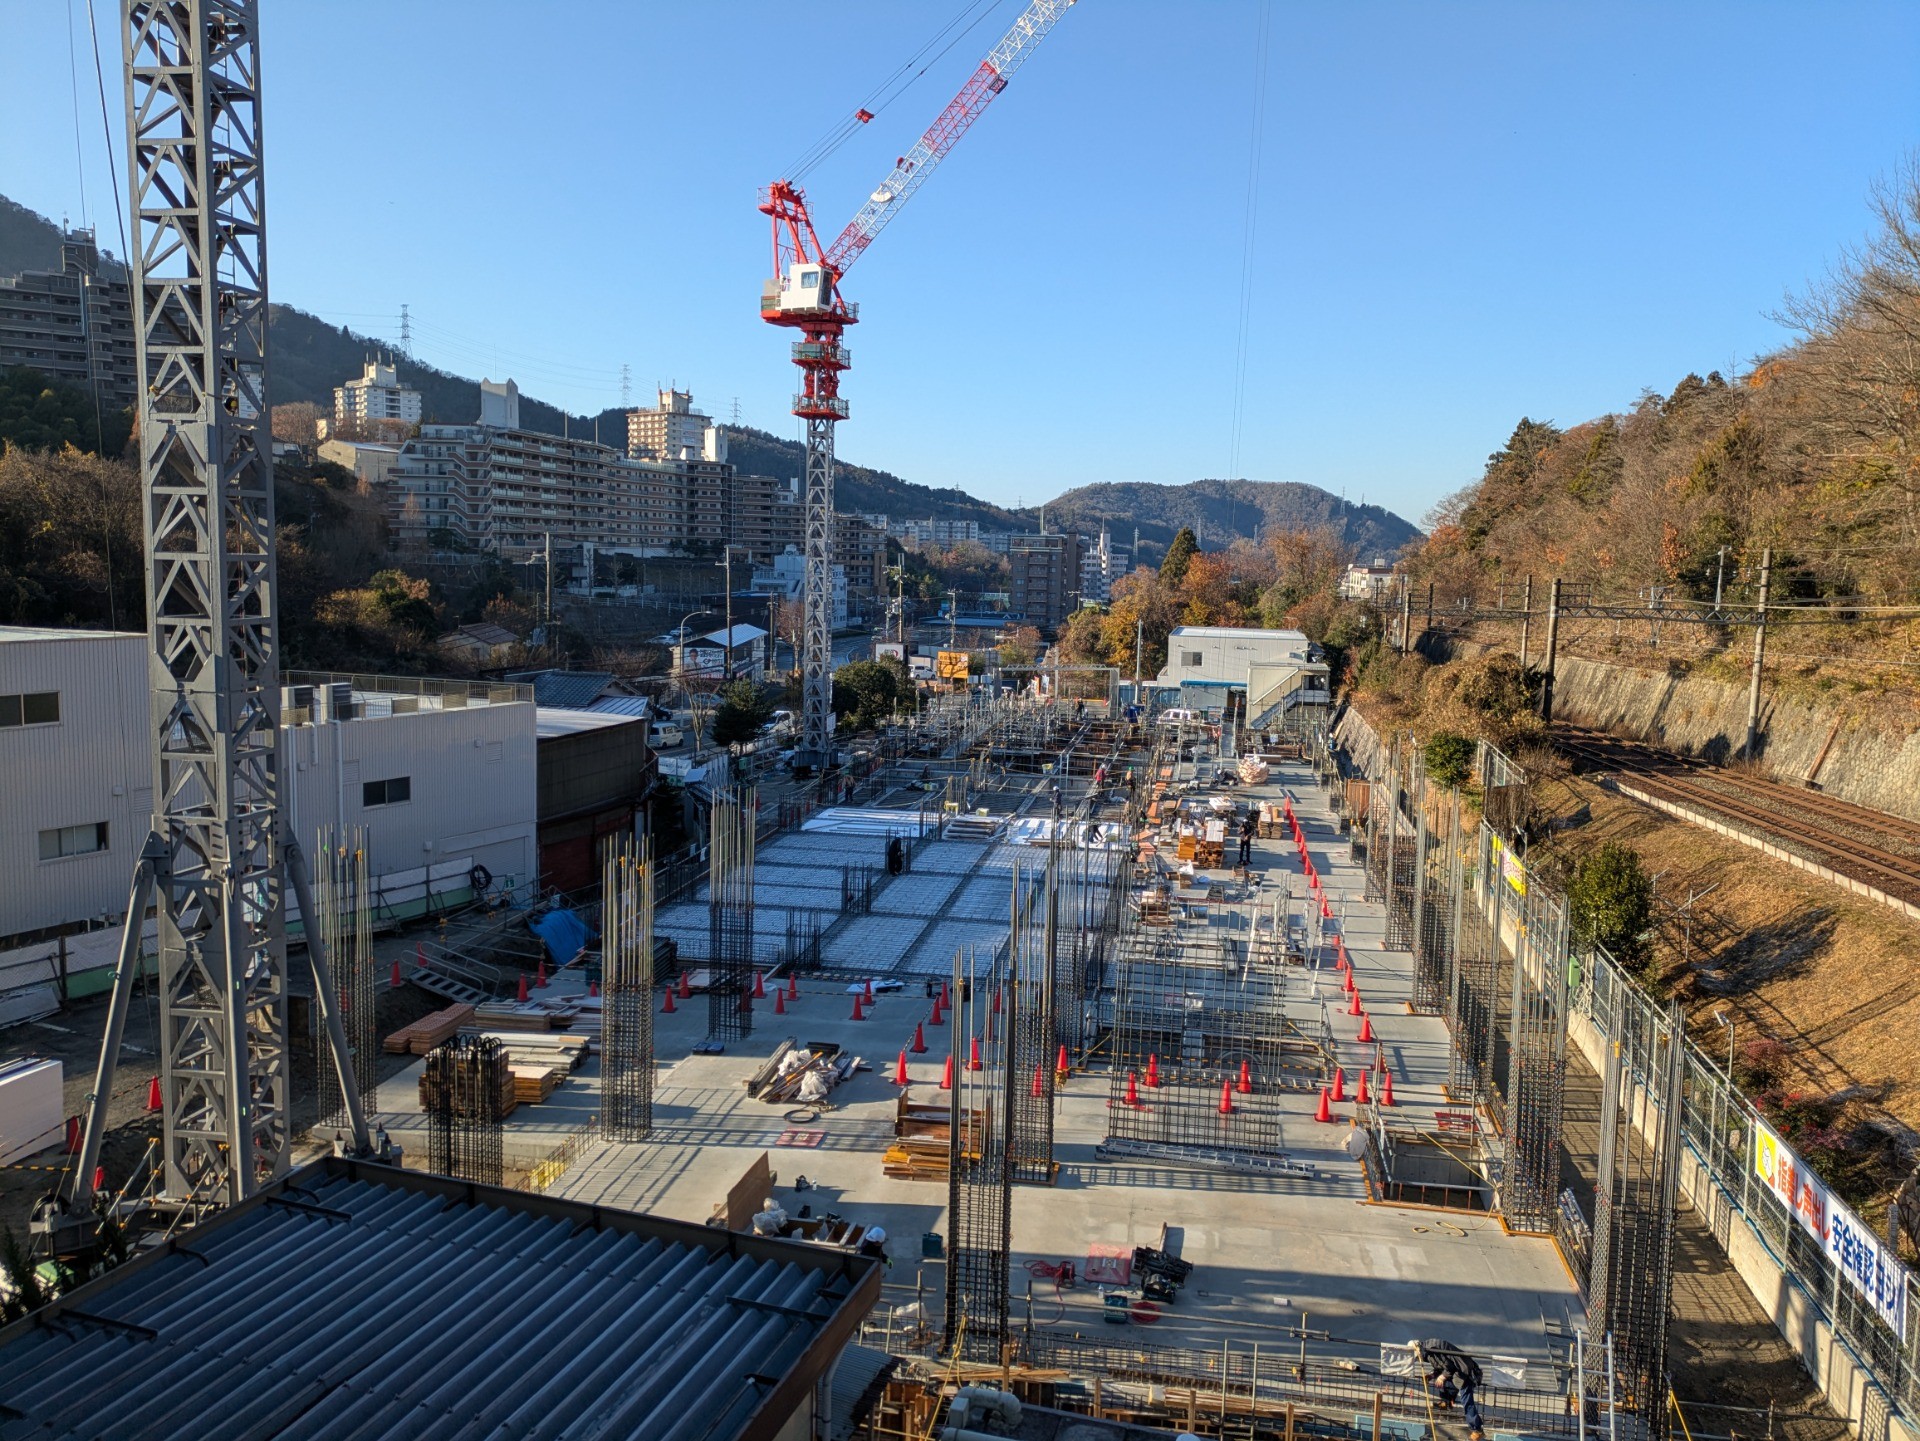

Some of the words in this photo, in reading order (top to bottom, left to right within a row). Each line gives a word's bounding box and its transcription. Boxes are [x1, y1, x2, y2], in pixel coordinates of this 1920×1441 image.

[1777, 1153, 1831, 1241] 指差し声出し
